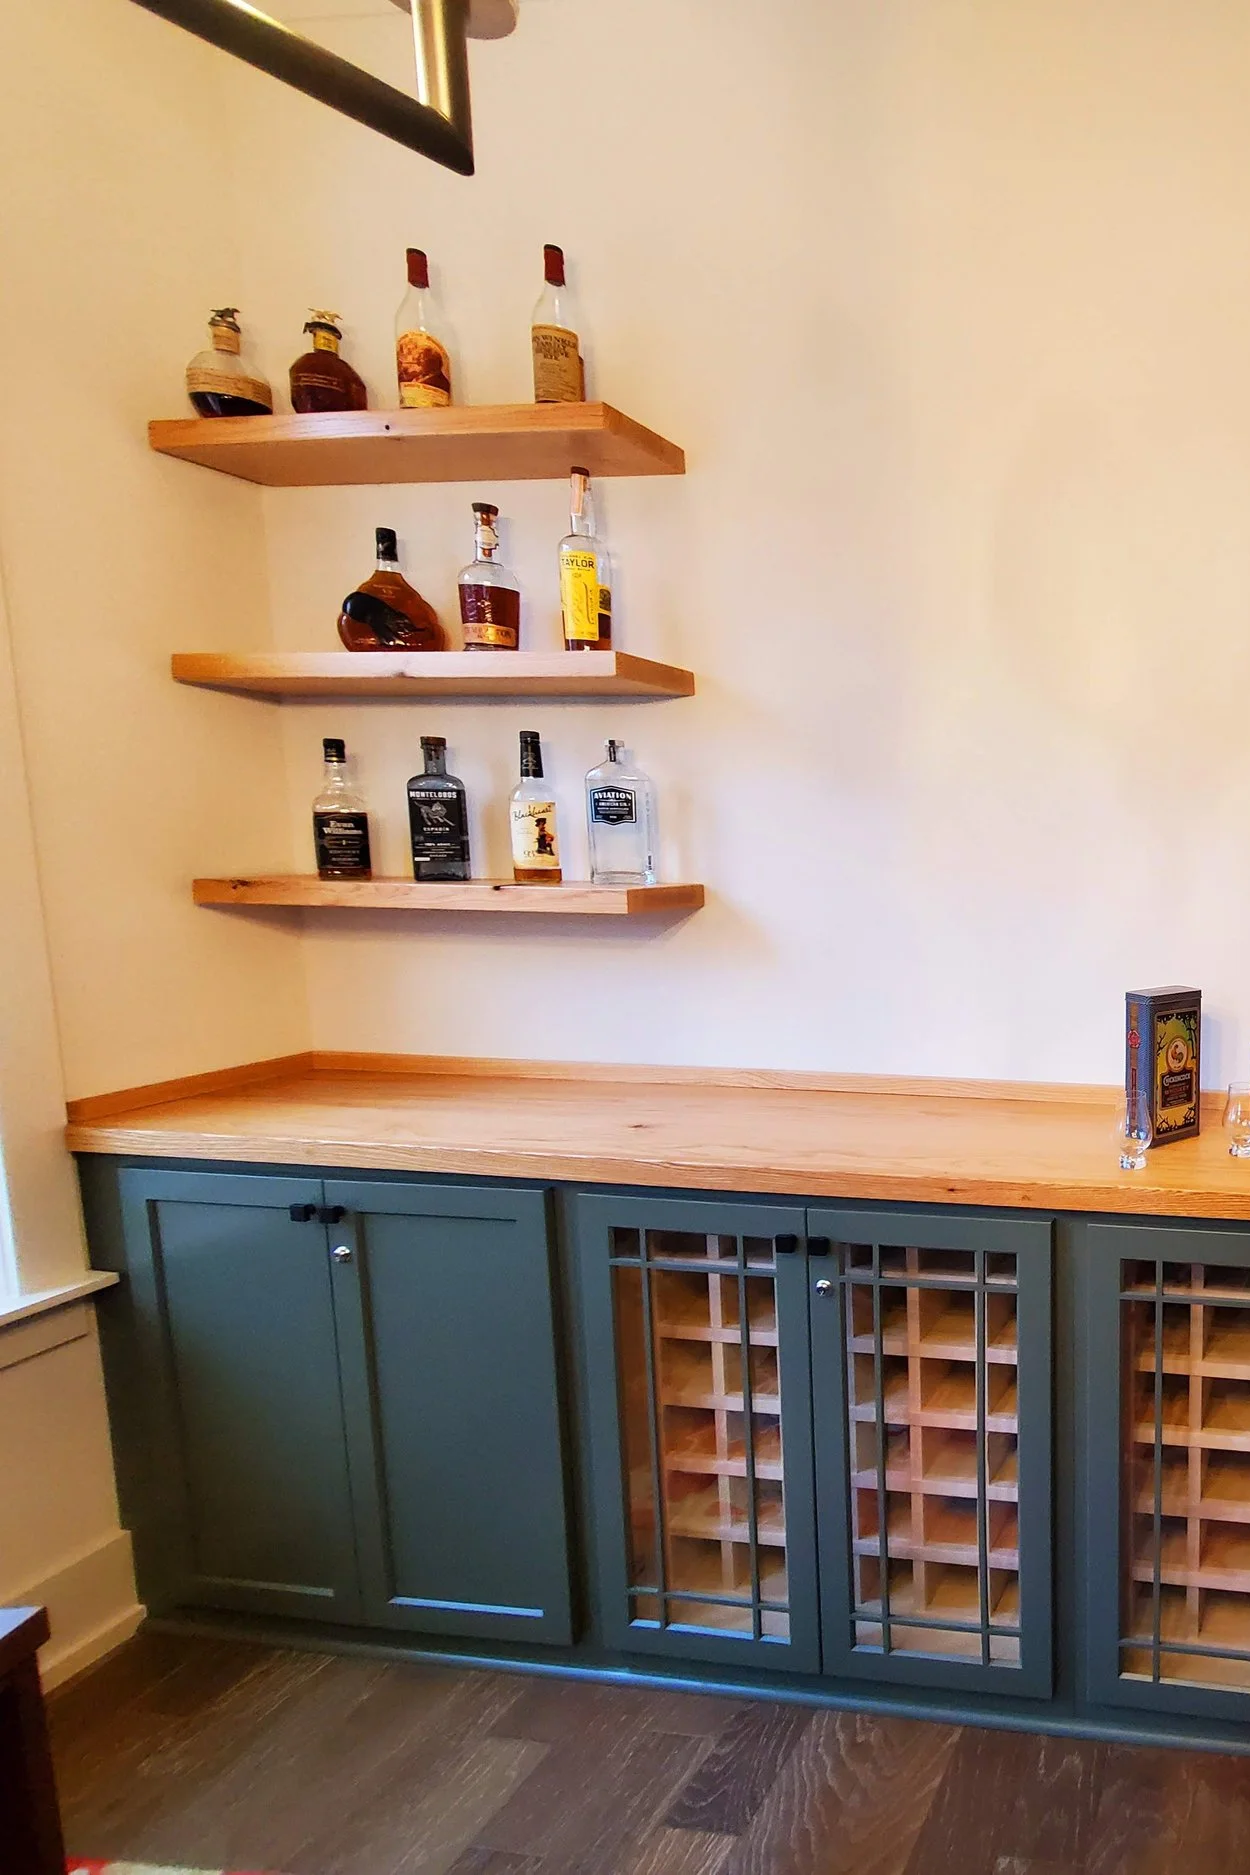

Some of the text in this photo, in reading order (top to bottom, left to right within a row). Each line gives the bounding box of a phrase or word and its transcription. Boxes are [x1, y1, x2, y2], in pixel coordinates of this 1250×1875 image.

[561, 558, 595, 569] TAYLOR
[409, 790, 458, 799] MONTELOBOS
[594, 791, 632, 800] AVIATION
[329, 820, 355, 828] Evan
